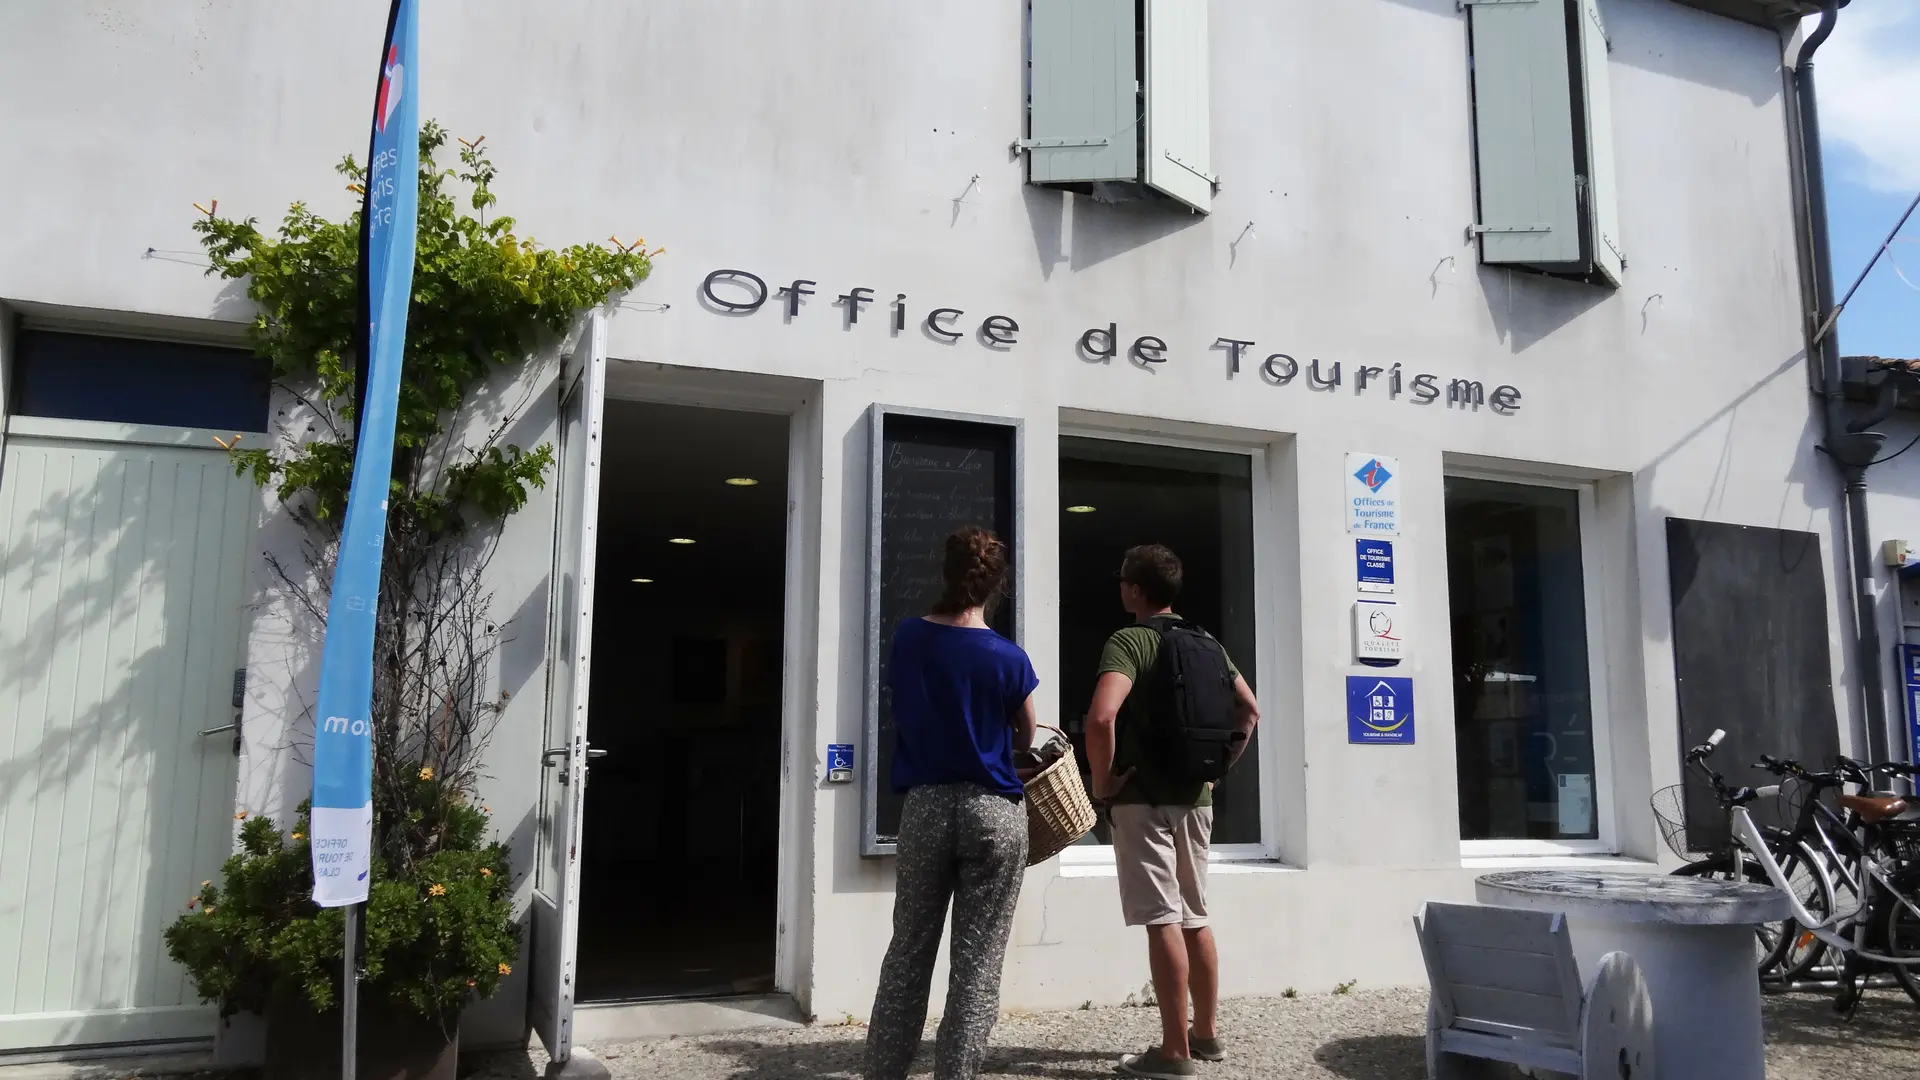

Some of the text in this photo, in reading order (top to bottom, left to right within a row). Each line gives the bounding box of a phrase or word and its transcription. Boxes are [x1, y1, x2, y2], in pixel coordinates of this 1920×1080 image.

[703, 268, 1522, 412] Office de Tourisme
[1353, 497, 1385, 506] Offices
[1354, 508, 1395, 518] Tourisme
[1364, 519, 1395, 530] France
[1367, 554, 1391, 563] TOURISME
